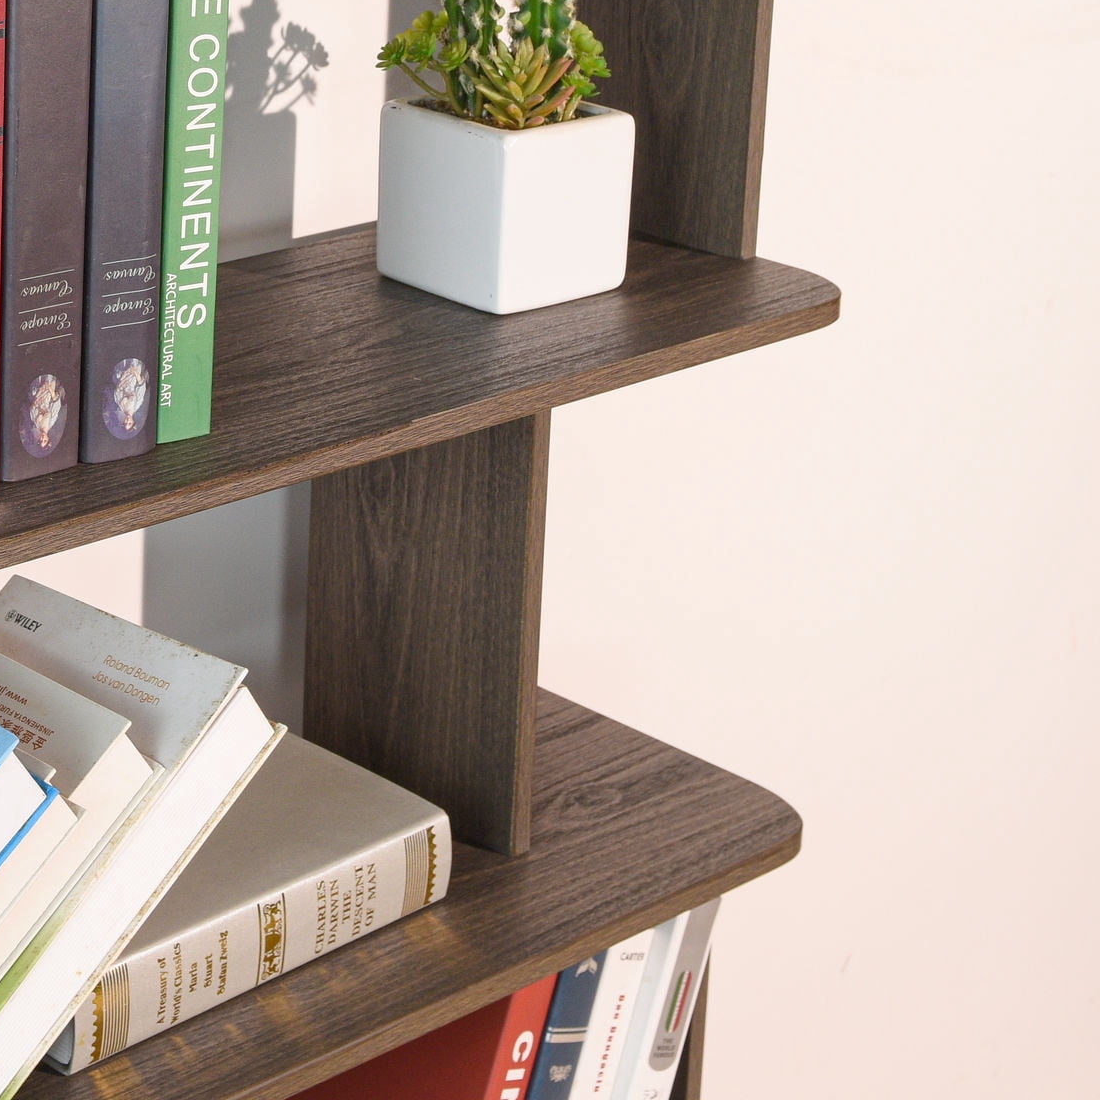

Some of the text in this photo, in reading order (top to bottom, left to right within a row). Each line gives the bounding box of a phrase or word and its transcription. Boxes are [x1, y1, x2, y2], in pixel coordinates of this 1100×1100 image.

[176, 33, 221, 329] CONTINENTS
[20, 279, 73, 298] Canvas
[103, 264, 156, 283] Canvas
[19, 312, 71, 331] Europe
[102, 297, 155, 316] Europe
[159, 273, 177, 407] ARCHITECTURAL ART
[15, 613, 42, 632] WILEY
[92, 671, 162, 707] Jos van Dongen
[103, 654, 171, 691] Roland Bouman
[13, 710, 55, 736] JINSHENGYA
[327, 879, 339, 944] DARWIN
[341, 890, 352, 925] THE
[352, 865, 364, 936] DESCENT
[365, 863, 377, 927] OF MAN
[314, 880, 326, 954] CHARLES
[173, 942, 182, 987] Classics
[204, 953, 213, 988] Stuart
[157, 957, 168, 1024] A Treasury of
